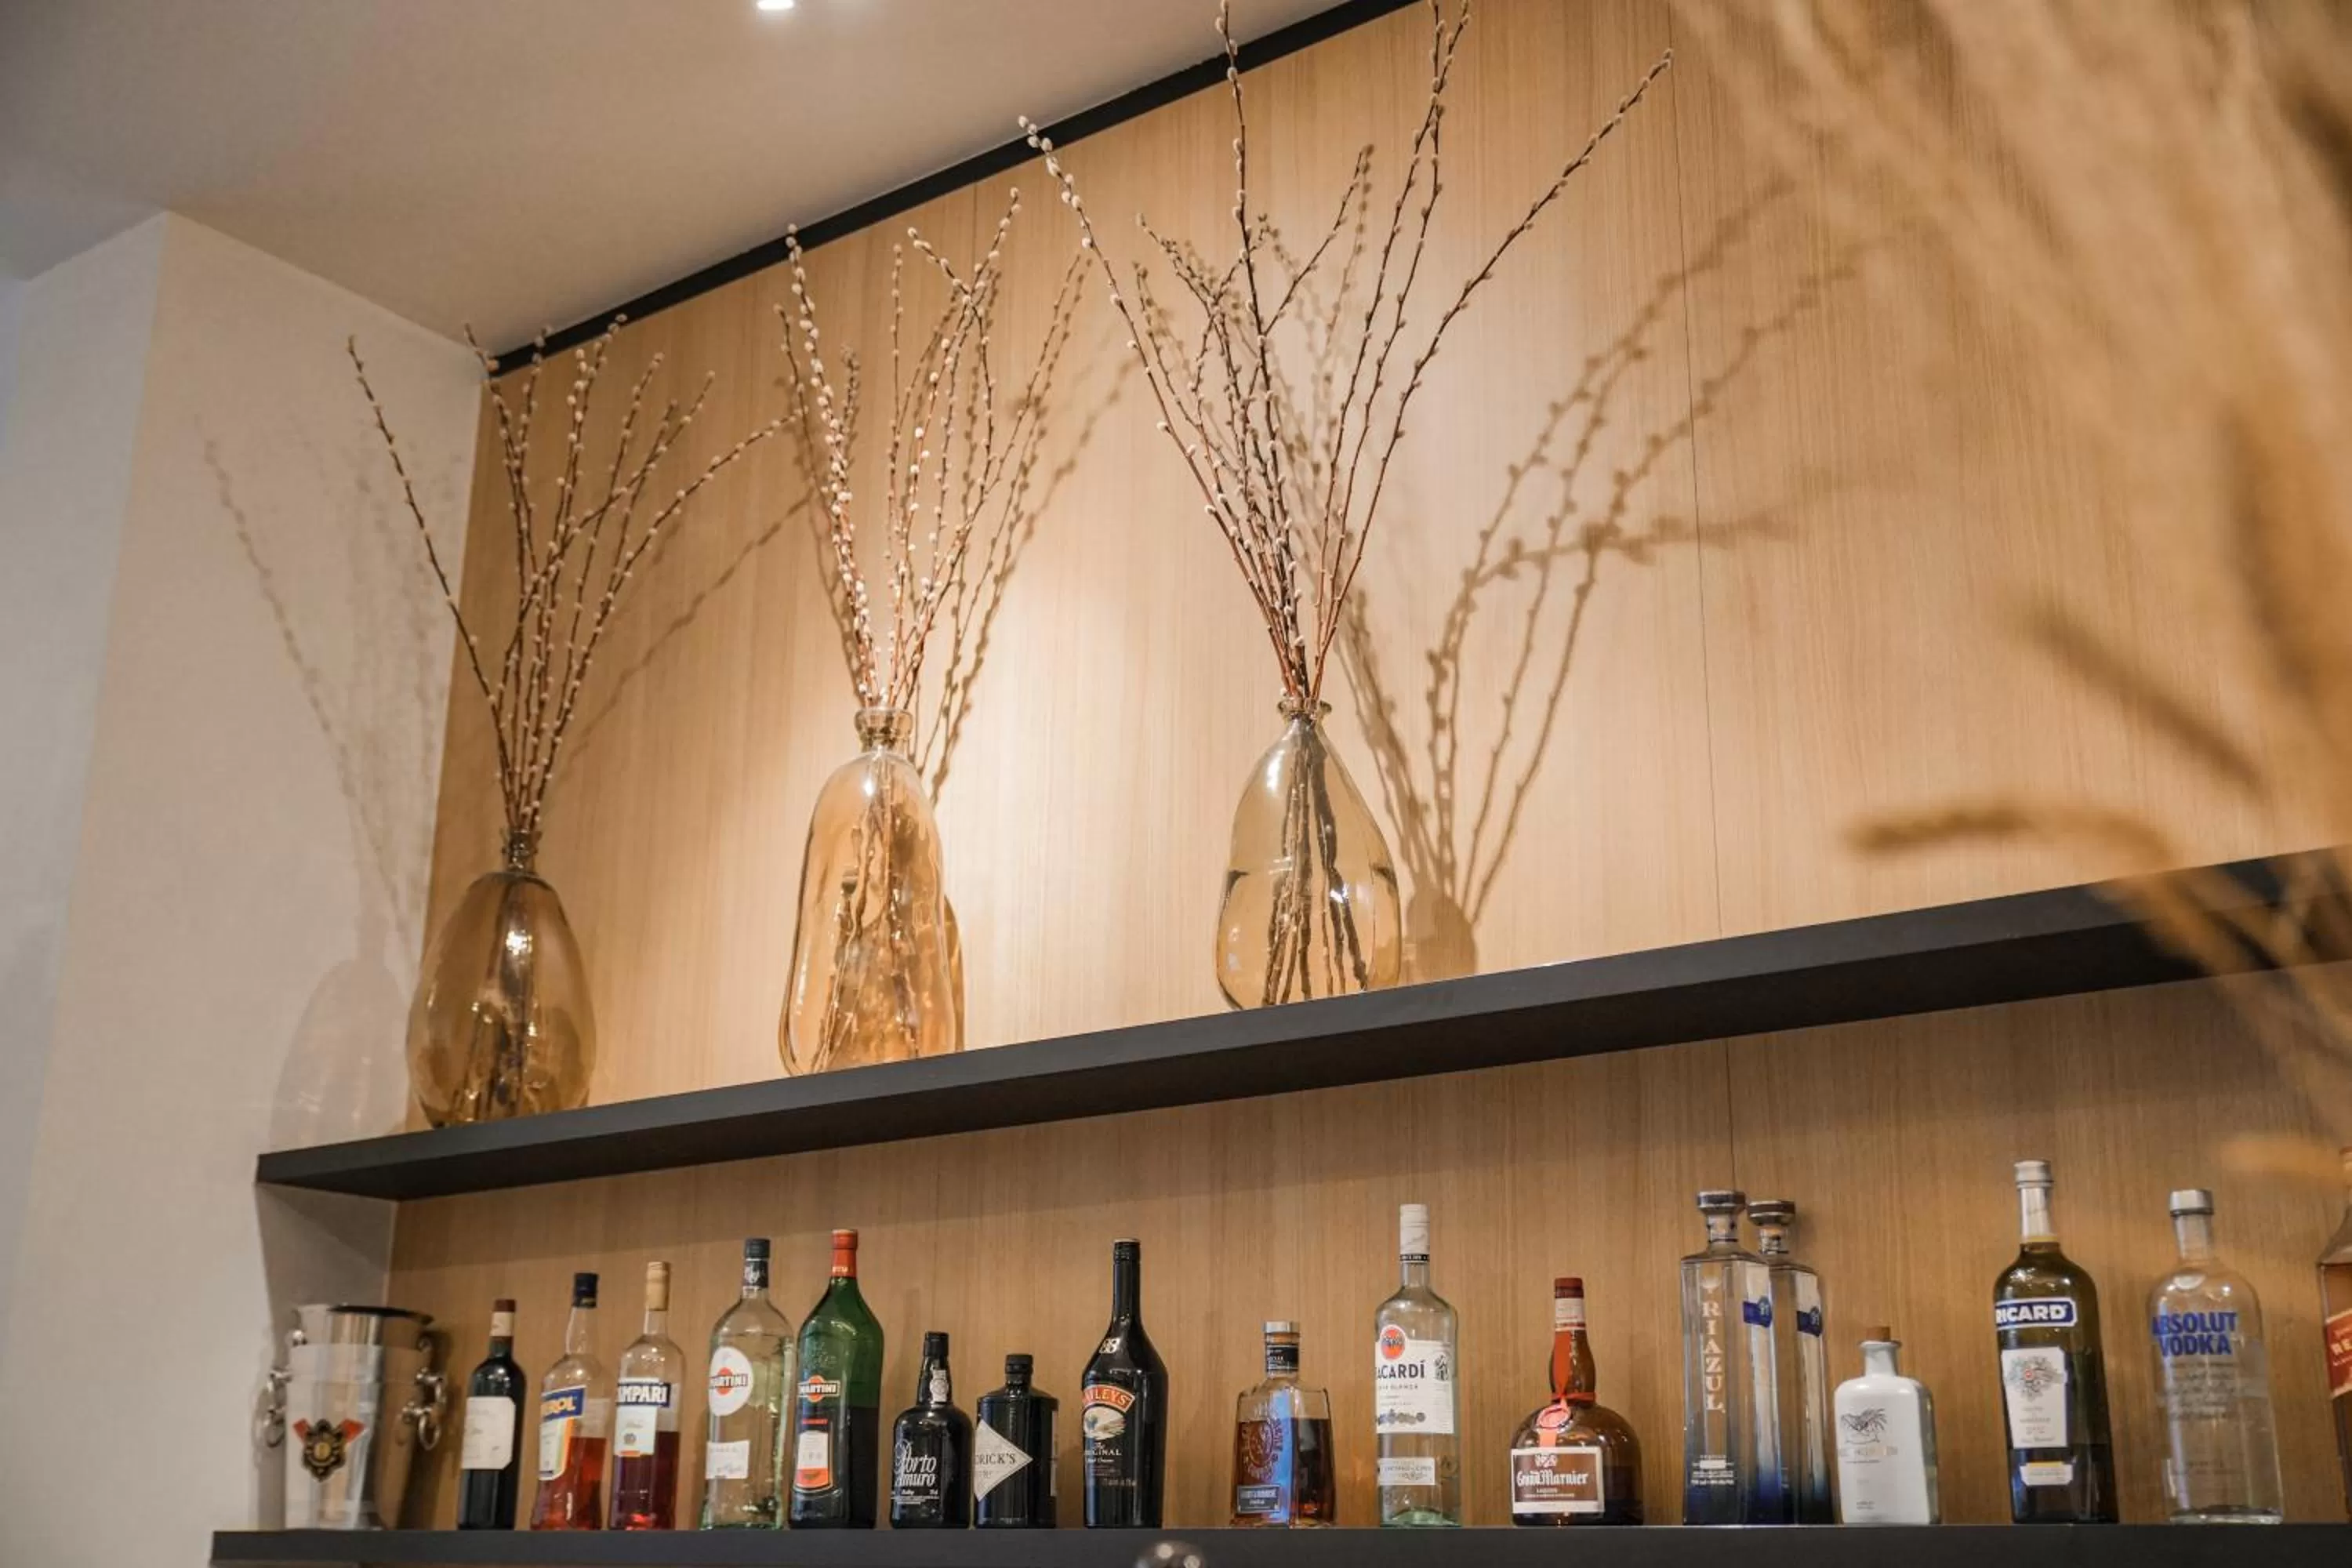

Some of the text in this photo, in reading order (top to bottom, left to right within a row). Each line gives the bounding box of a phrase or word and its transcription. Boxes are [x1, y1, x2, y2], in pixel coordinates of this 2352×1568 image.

[1995, 1305, 2066, 1323] RICARD
[2152, 1312, 2236, 1336] ABSOLUT
[2160, 1334, 2231, 1357] VODKA
[1701, 1301, 1725, 1413] RIAZUL
[1377, 1359, 1425, 1380] ACARDÍ
[1539, 1468, 1588, 1486] Marnier
